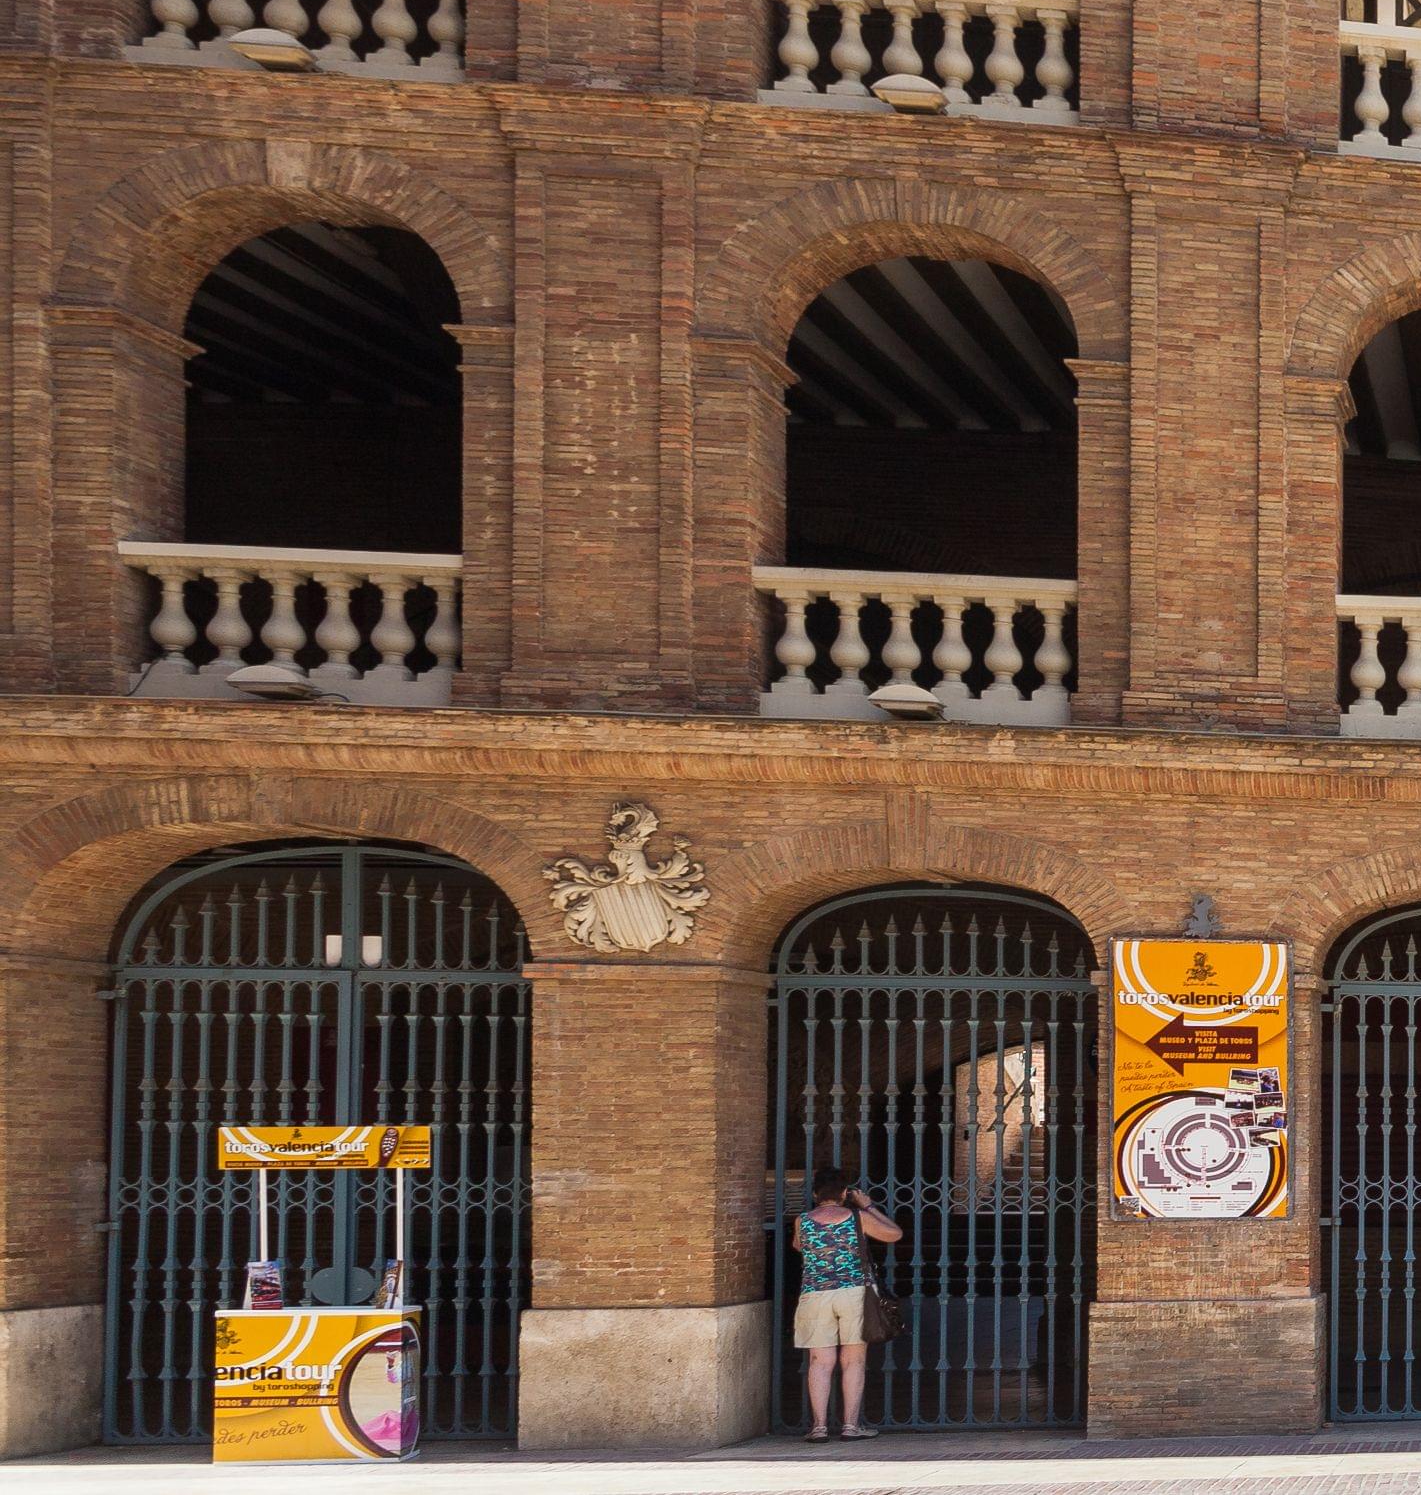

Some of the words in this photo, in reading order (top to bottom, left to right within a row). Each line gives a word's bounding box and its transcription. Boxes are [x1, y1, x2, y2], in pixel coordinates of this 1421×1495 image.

[252, 1384, 265, 1393] by
[268, 1383, 335, 1392] toroshopping
[250, 1398, 289, 1406] MUSEUM
[297, 1397, 338, 1406] BULLRING
[247, 1419, 308, 1446] perder
